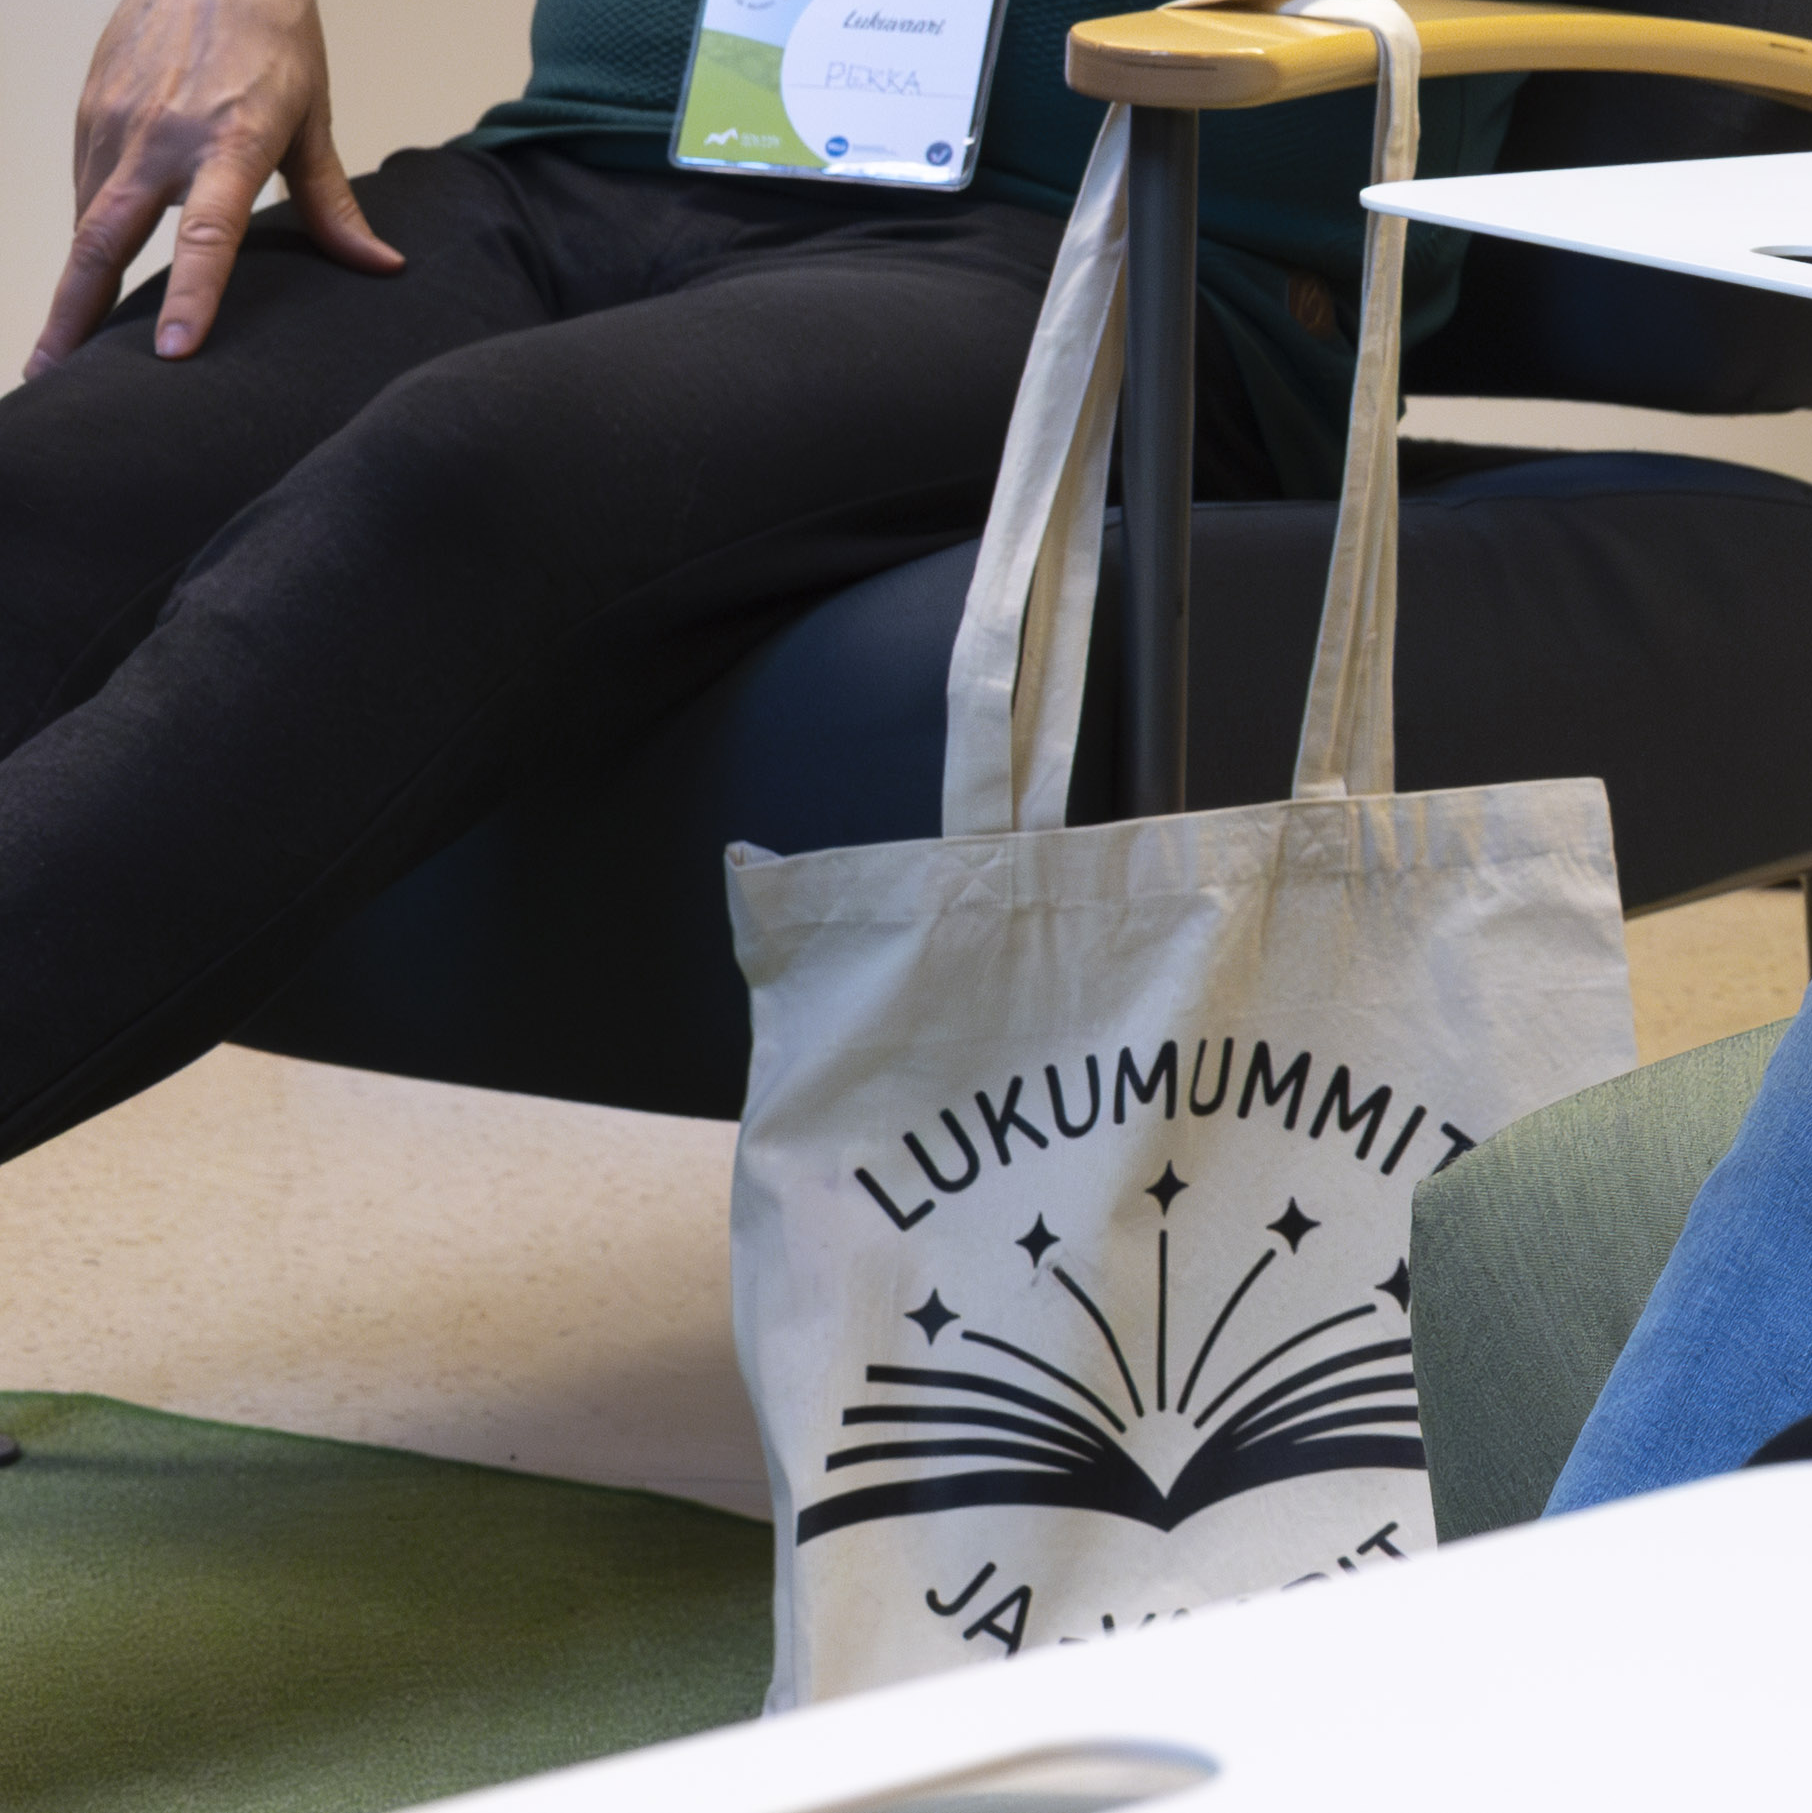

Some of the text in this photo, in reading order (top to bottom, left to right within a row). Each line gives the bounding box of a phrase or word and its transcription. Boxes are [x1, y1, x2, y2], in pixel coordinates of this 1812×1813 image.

[825, 61, 922, 96] PEKKA
[853, 1036, 1478, 1232] LUKUMUMMIT
[925, 1560, 1033, 1659] JA
